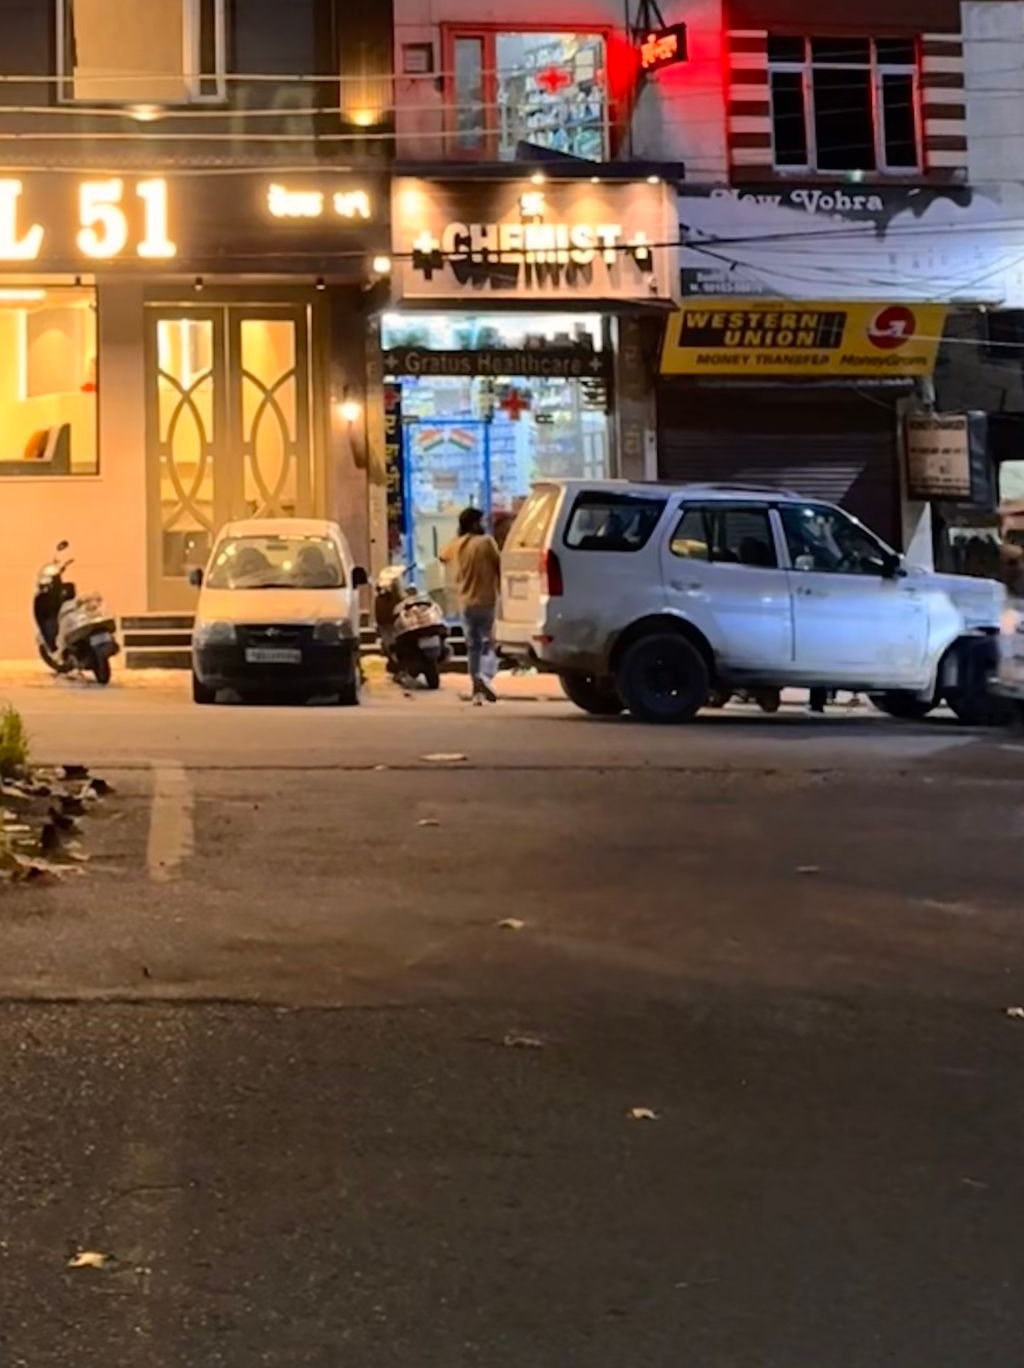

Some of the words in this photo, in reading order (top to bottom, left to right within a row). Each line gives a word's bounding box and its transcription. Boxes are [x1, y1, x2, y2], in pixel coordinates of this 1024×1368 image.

[790, 189, 884, 214] Vohra
[77, 178, 176, 258] 51
[442, 222, 622, 264] CHEMIST
[686, 313, 818, 329] WESTERN
[724, 330, 815, 346] UNION
[405, 352, 471, 372] Gratus
[477, 353, 581, 374] Healthcare
[696, 353, 751, 366] MONEY
[756, 353, 830, 366] TRANSFER
